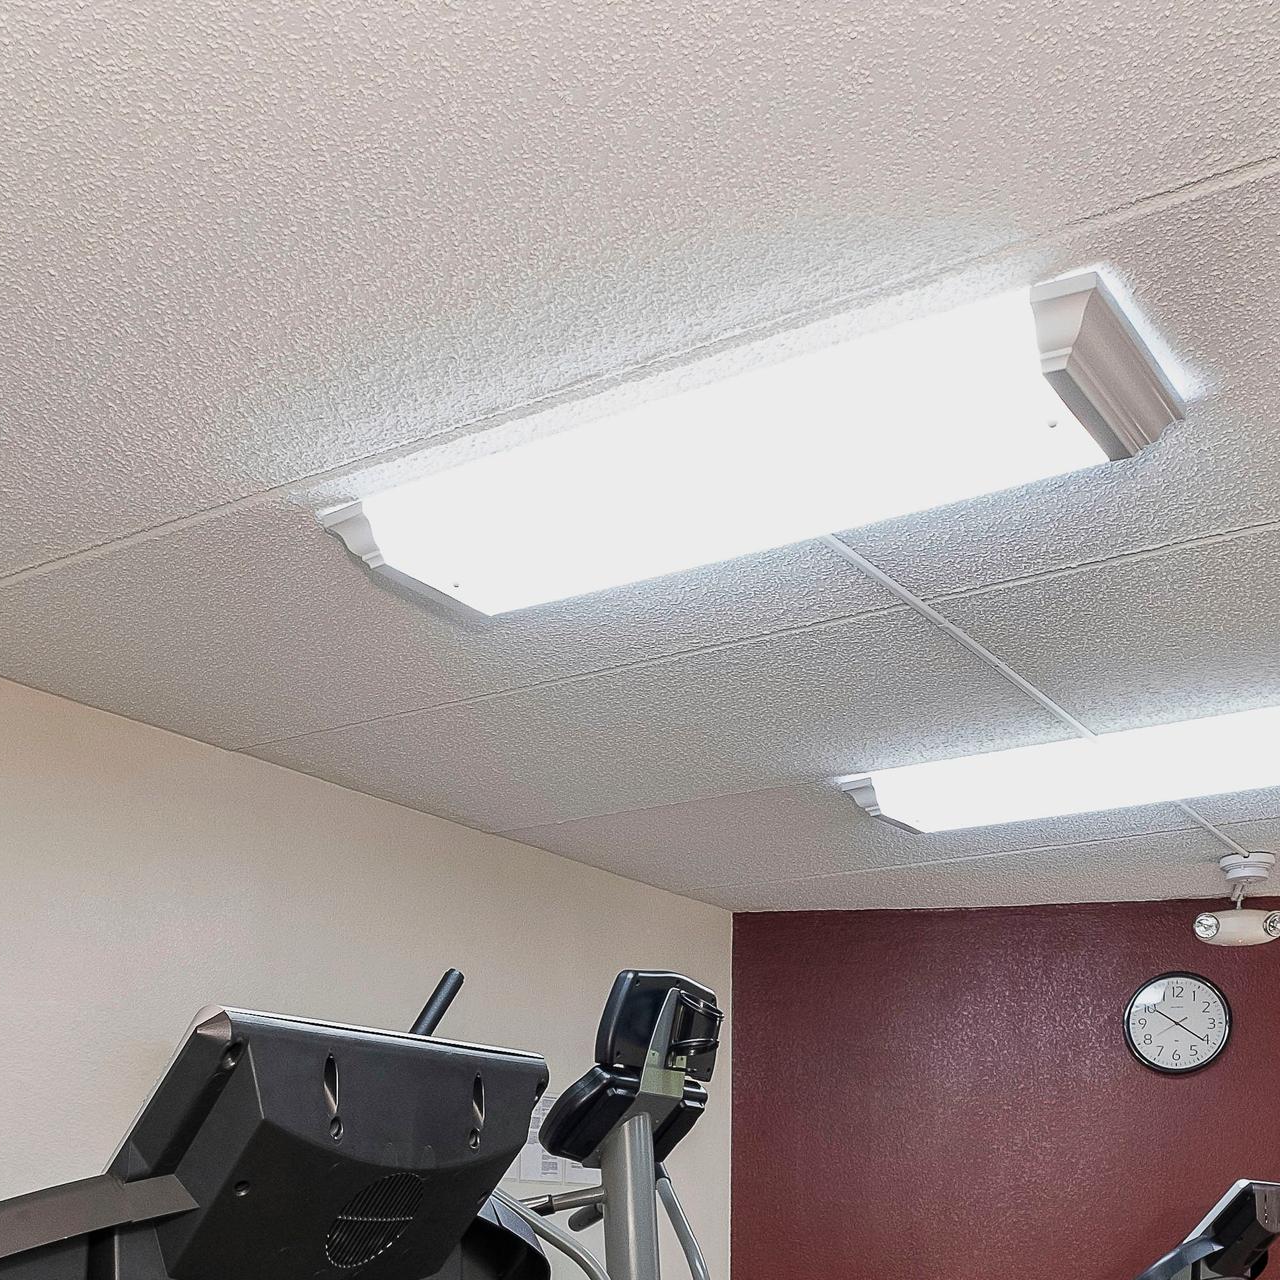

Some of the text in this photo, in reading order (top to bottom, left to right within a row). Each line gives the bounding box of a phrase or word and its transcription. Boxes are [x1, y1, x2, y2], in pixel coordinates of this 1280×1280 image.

[1172, 986, 1184, 998] 12
[1202, 1001, 1211, 1013] 2
[1138, 1018, 1147, 1030] 9
[1207, 1017, 1216, 1030] 3
[1143, 1033, 1153, 1045] 8
[1202, 1033, 1210, 1045] 4
[1156, 1045, 1164, 1057] 7
[1172, 1049, 1181, 1061] 6
[1189, 1045, 1199, 1056] 5
